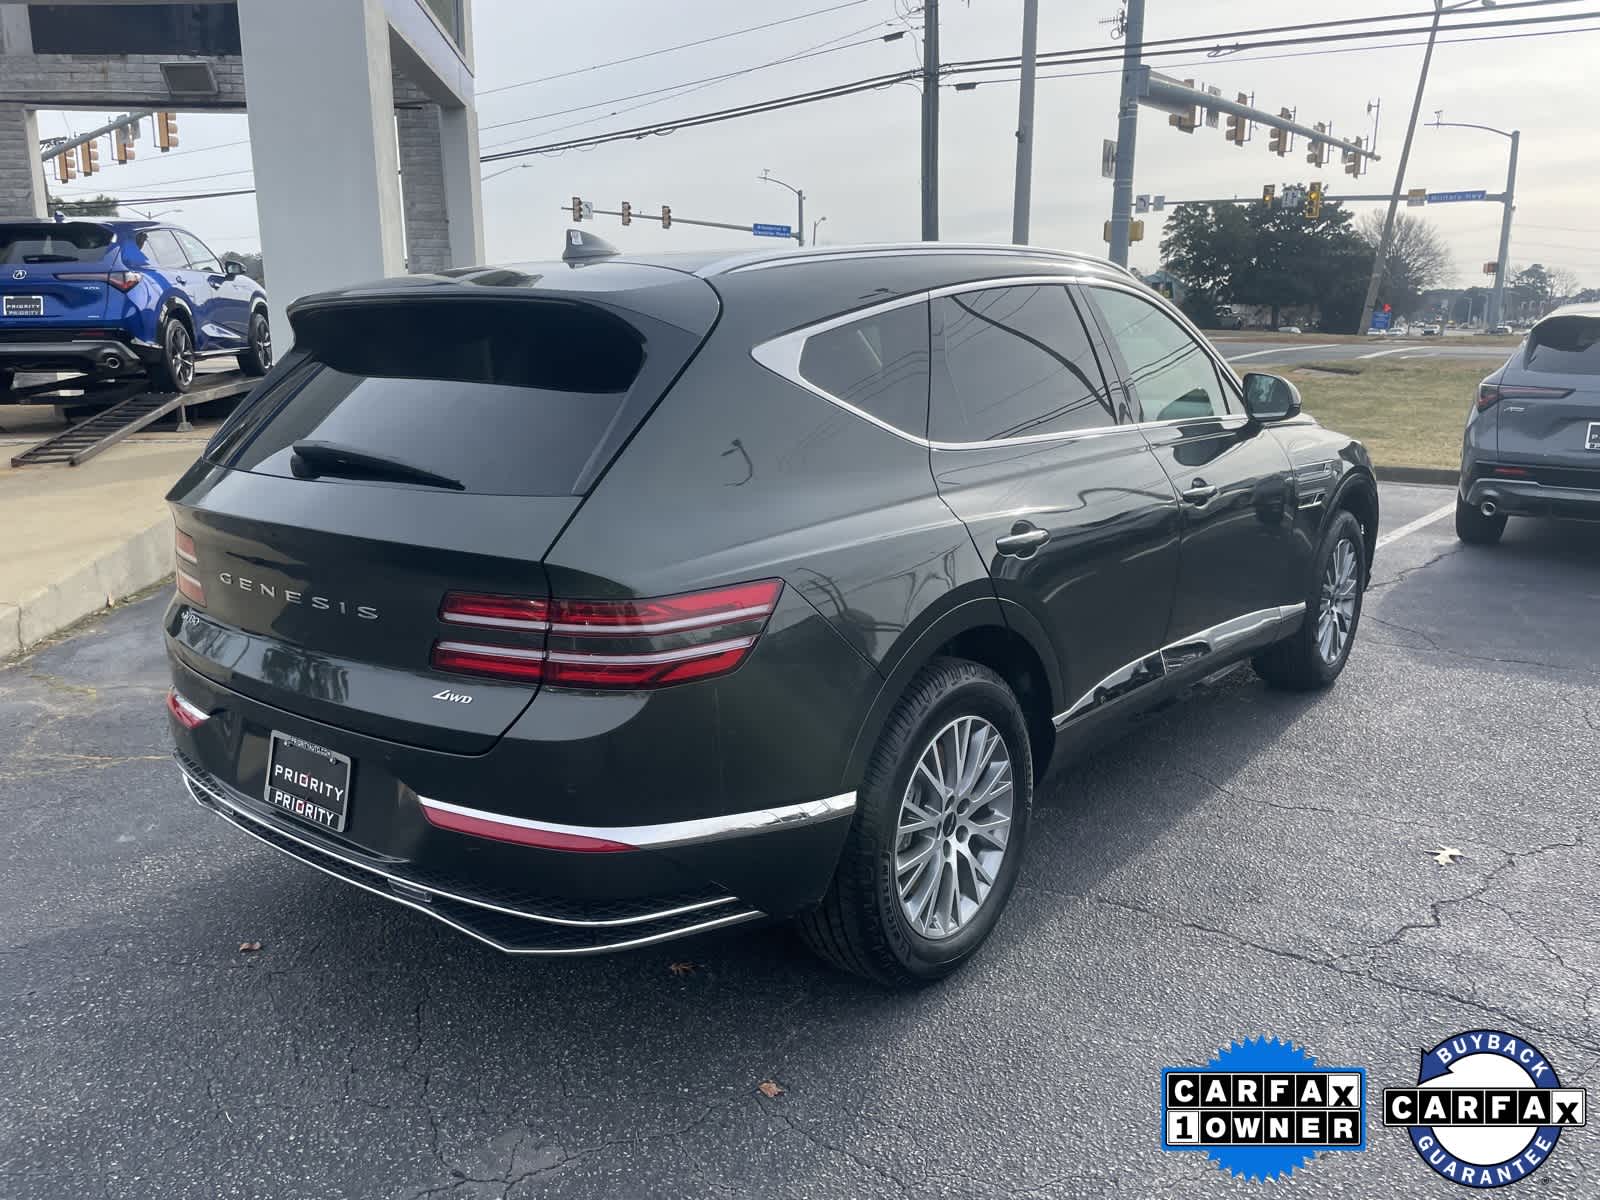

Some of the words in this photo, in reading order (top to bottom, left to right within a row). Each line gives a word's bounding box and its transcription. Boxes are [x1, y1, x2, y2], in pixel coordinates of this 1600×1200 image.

[219, 572, 379, 620] GENESIS
[432, 689, 473, 704] AWD
[274, 764, 344, 802] PRIORITY
[274, 790, 334, 826] PRIORITY
